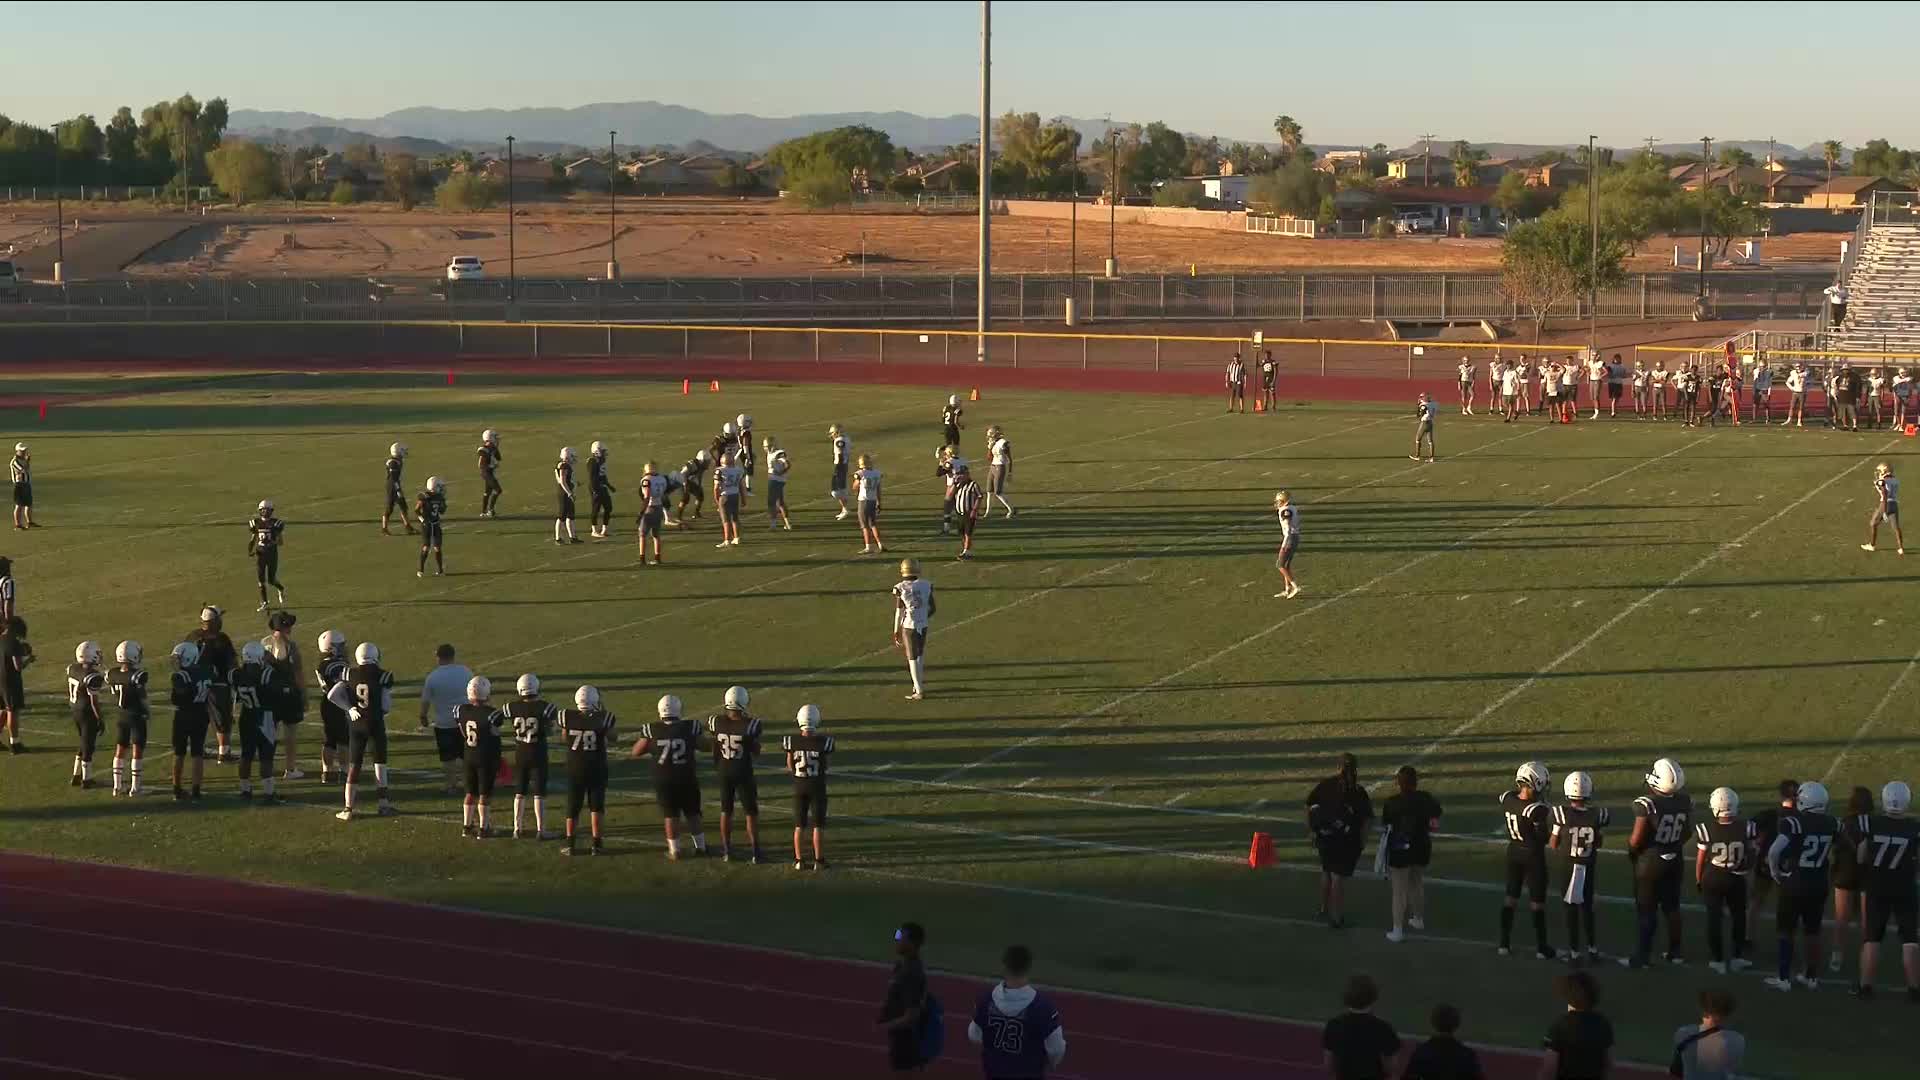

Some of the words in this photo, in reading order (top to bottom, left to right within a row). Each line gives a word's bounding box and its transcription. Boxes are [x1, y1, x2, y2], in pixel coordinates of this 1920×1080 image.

[944, 413, 953, 426] 2
[355, 683, 369, 709] 9
[465, 720, 478, 748] 6
[512, 717, 538, 744] 22
[568, 729, 597, 752] 78
[655, 738, 687, 765] 72
[716, 733, 743, 760] 35
[793, 751, 820, 777] 25
[1504, 811, 1523, 842] 11
[1655, 813, 1687, 844] 66
[1568, 826, 1595, 858] 13
[1711, 840, 1745, 868] 20
[1799, 834, 1832, 868] 27
[1872, 834, 1910, 870] 77
[988, 1016, 1024, 1054] 73
